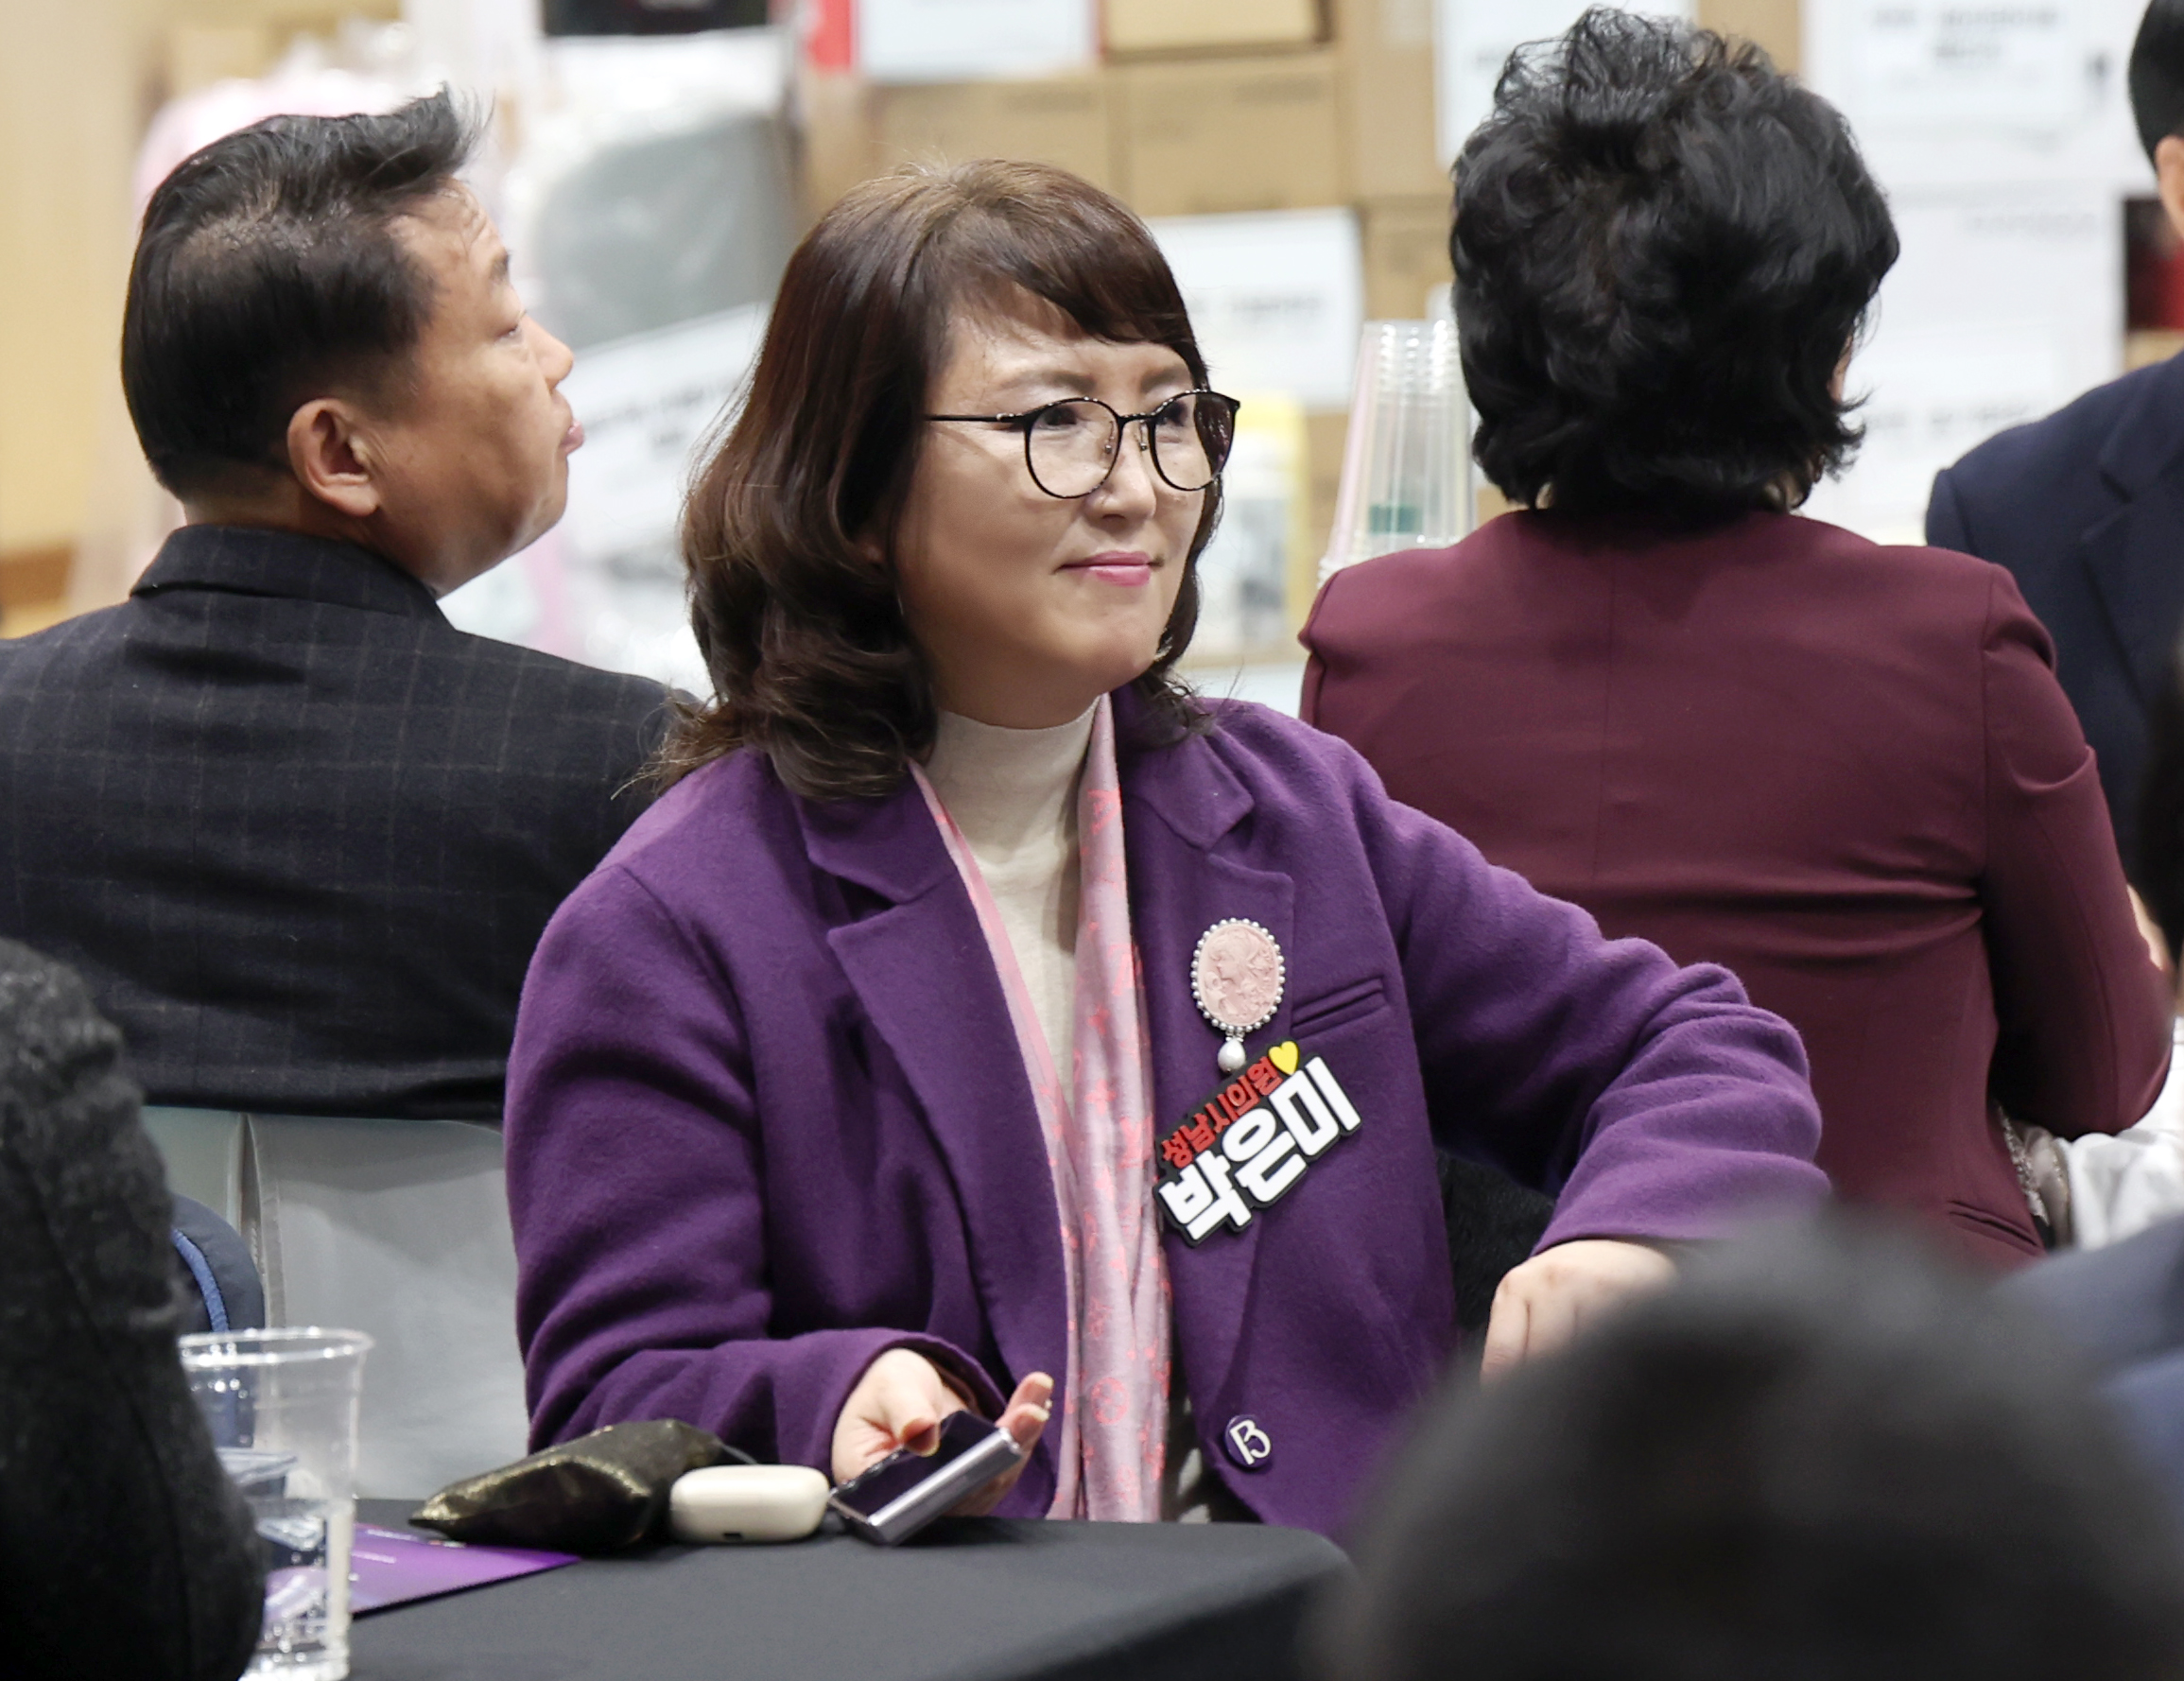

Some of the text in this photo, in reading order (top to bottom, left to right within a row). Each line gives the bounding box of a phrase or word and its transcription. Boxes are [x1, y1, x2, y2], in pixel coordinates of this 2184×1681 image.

[1158, 1056, 1361, 1240] 박은미
[1161, 1056, 1283, 1169] 성남시의원
[1229, 1419, 1271, 1464] B
